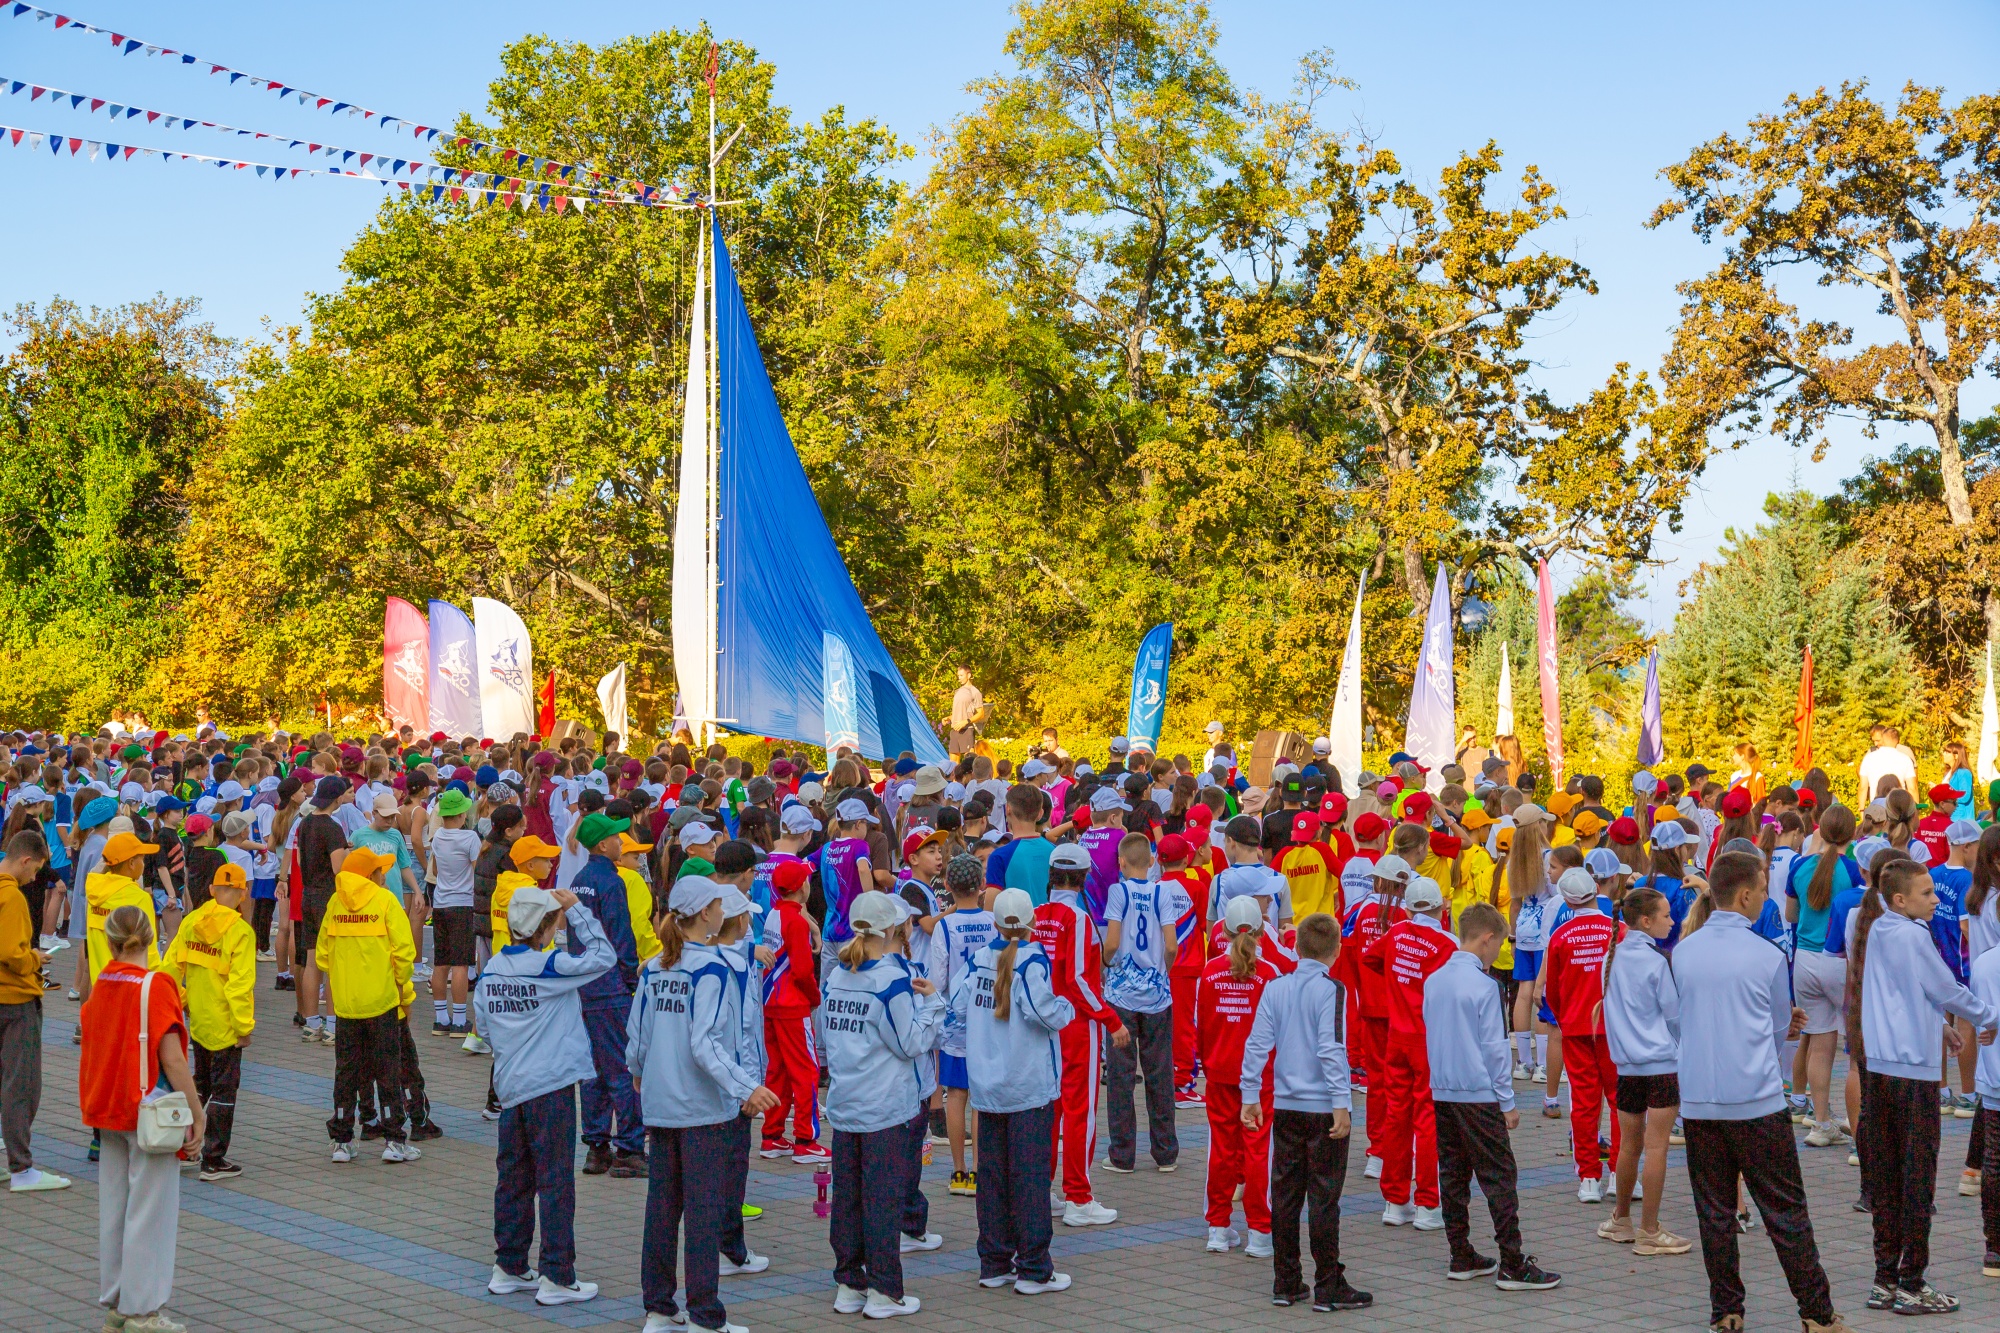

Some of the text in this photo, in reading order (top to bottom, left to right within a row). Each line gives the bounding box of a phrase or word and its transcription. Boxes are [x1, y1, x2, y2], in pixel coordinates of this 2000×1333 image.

[336, 914, 369, 924] ЧУВАШИЯ
[956, 923, 992, 933] ЧЕЛЯБИНСКАЯ
[1135, 912, 1149, 952] 8
[963, 934, 986, 944] ОБЛАСТЬ
[1567, 933, 1608, 945] БУРАШЕВО
[485, 983, 538, 998] ТВЕРСКАЯ
[1214, 982, 1255, 992] БУРАШЕВО
[488, 999, 540, 1014] ОБЛАСТЬ
